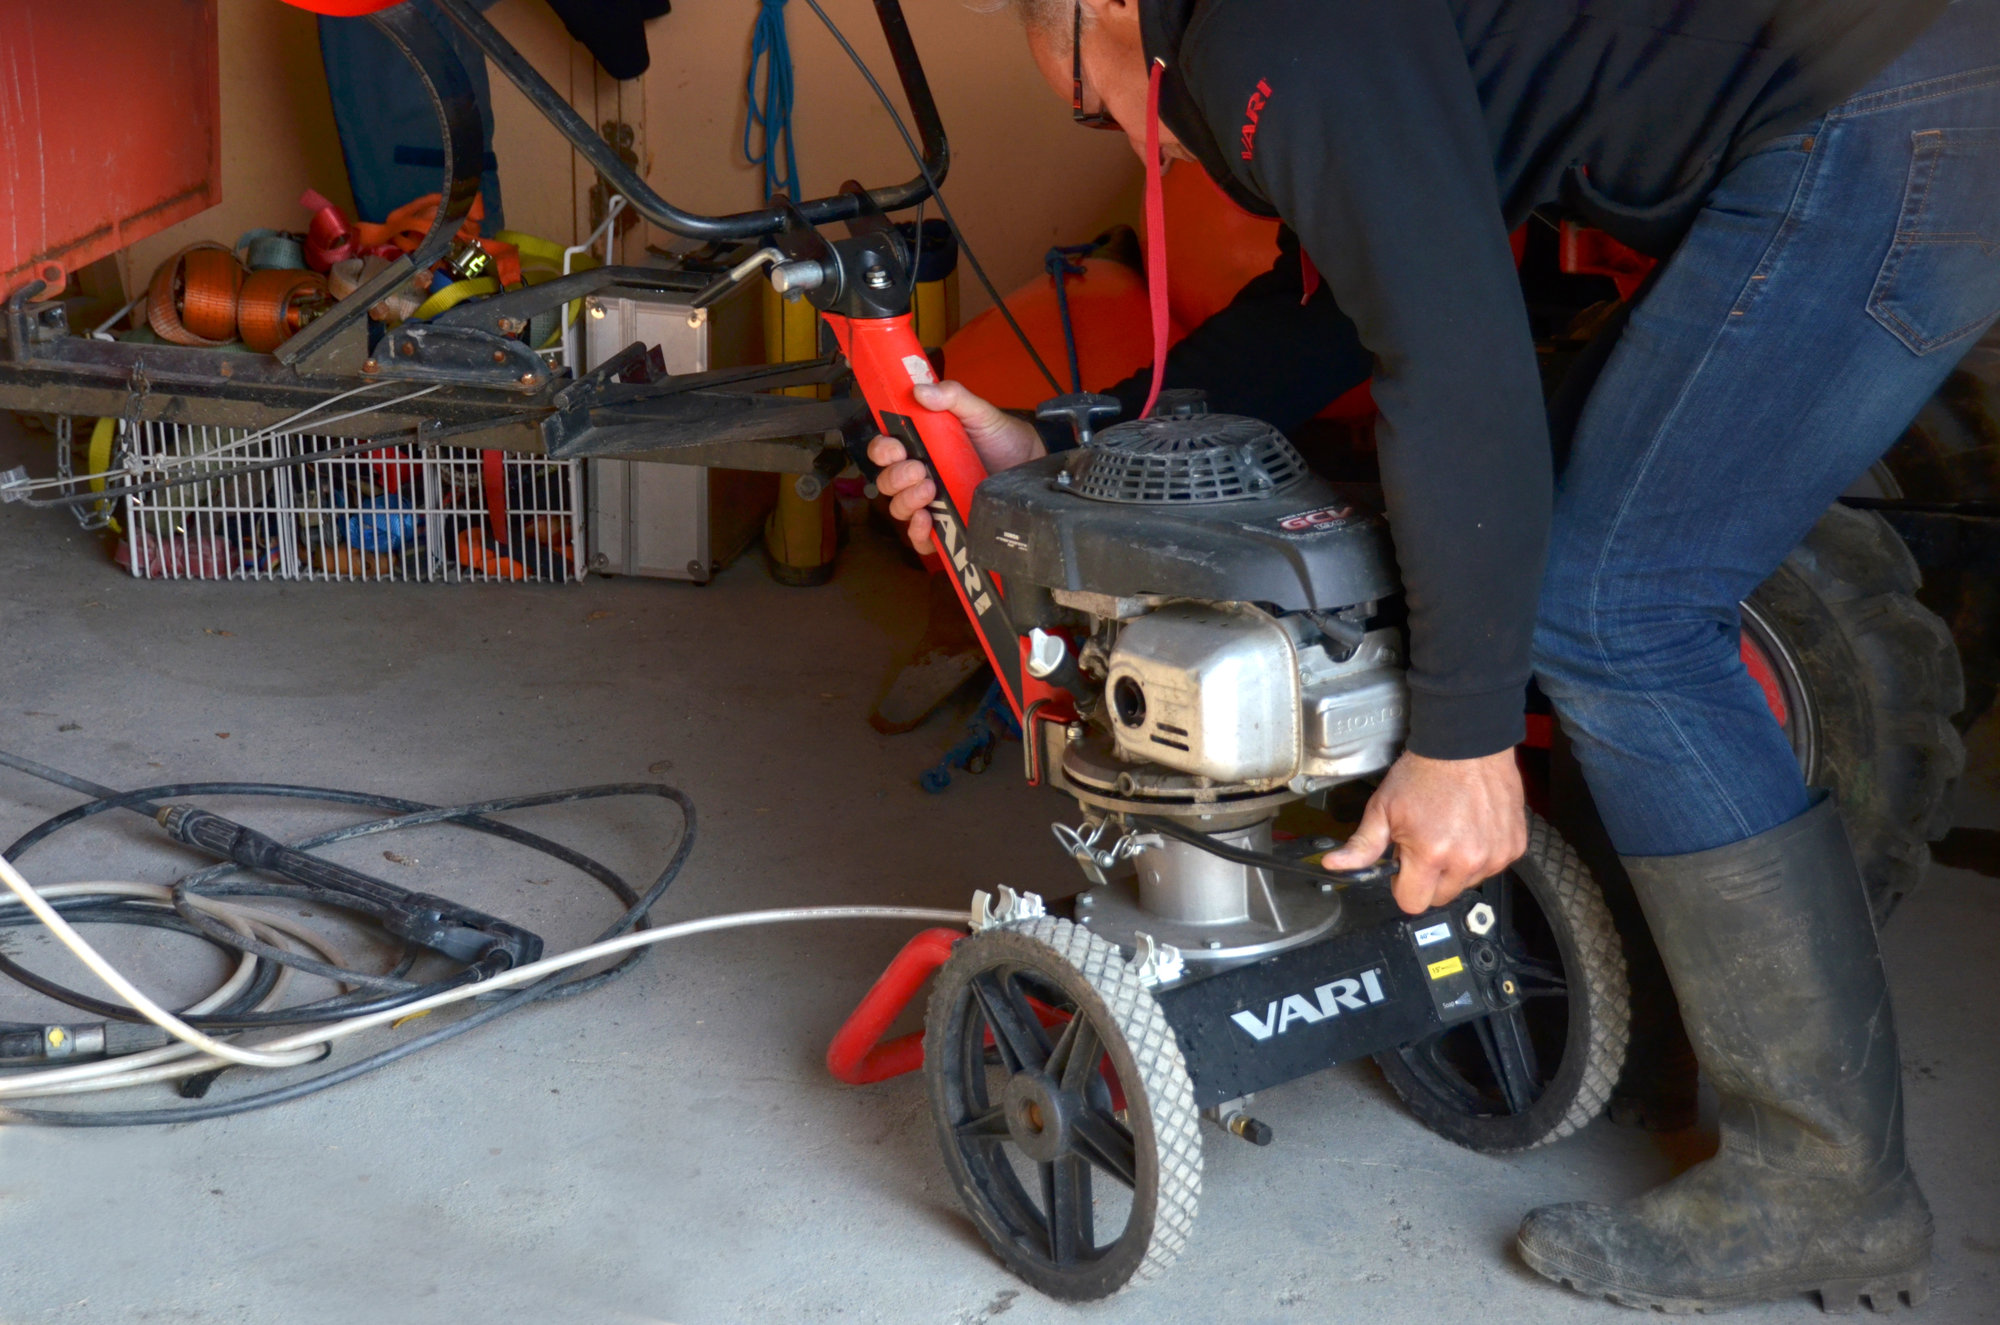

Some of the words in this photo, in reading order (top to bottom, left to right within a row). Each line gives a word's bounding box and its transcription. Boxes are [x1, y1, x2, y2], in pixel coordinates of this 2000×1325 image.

[1241, 78, 1272, 160] VARI
[1280, 506, 1352, 530] GCV
[928, 500, 992, 616] ARI
[1230, 969, 1384, 1040] VARI
